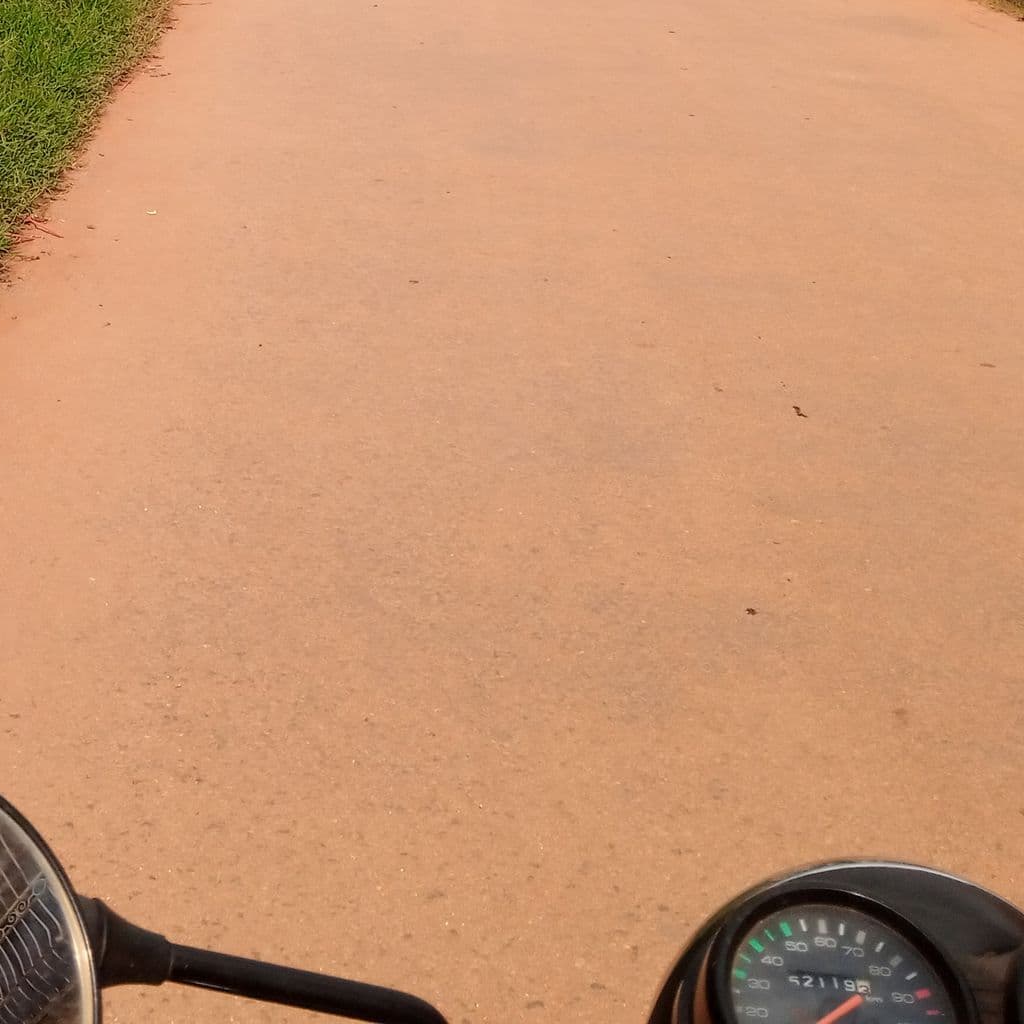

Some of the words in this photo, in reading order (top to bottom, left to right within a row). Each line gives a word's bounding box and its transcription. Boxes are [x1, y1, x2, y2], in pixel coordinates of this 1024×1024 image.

[784, 941, 808, 952] 50
[814, 937, 837, 948] 60
[841, 946, 865, 958] 70
[760, 955, 784, 967] 40
[869, 965, 892, 977] 80
[747, 978, 770, 990] 30
[891, 992, 914, 1004] 90
[745, 1007, 769, 1018] 20
